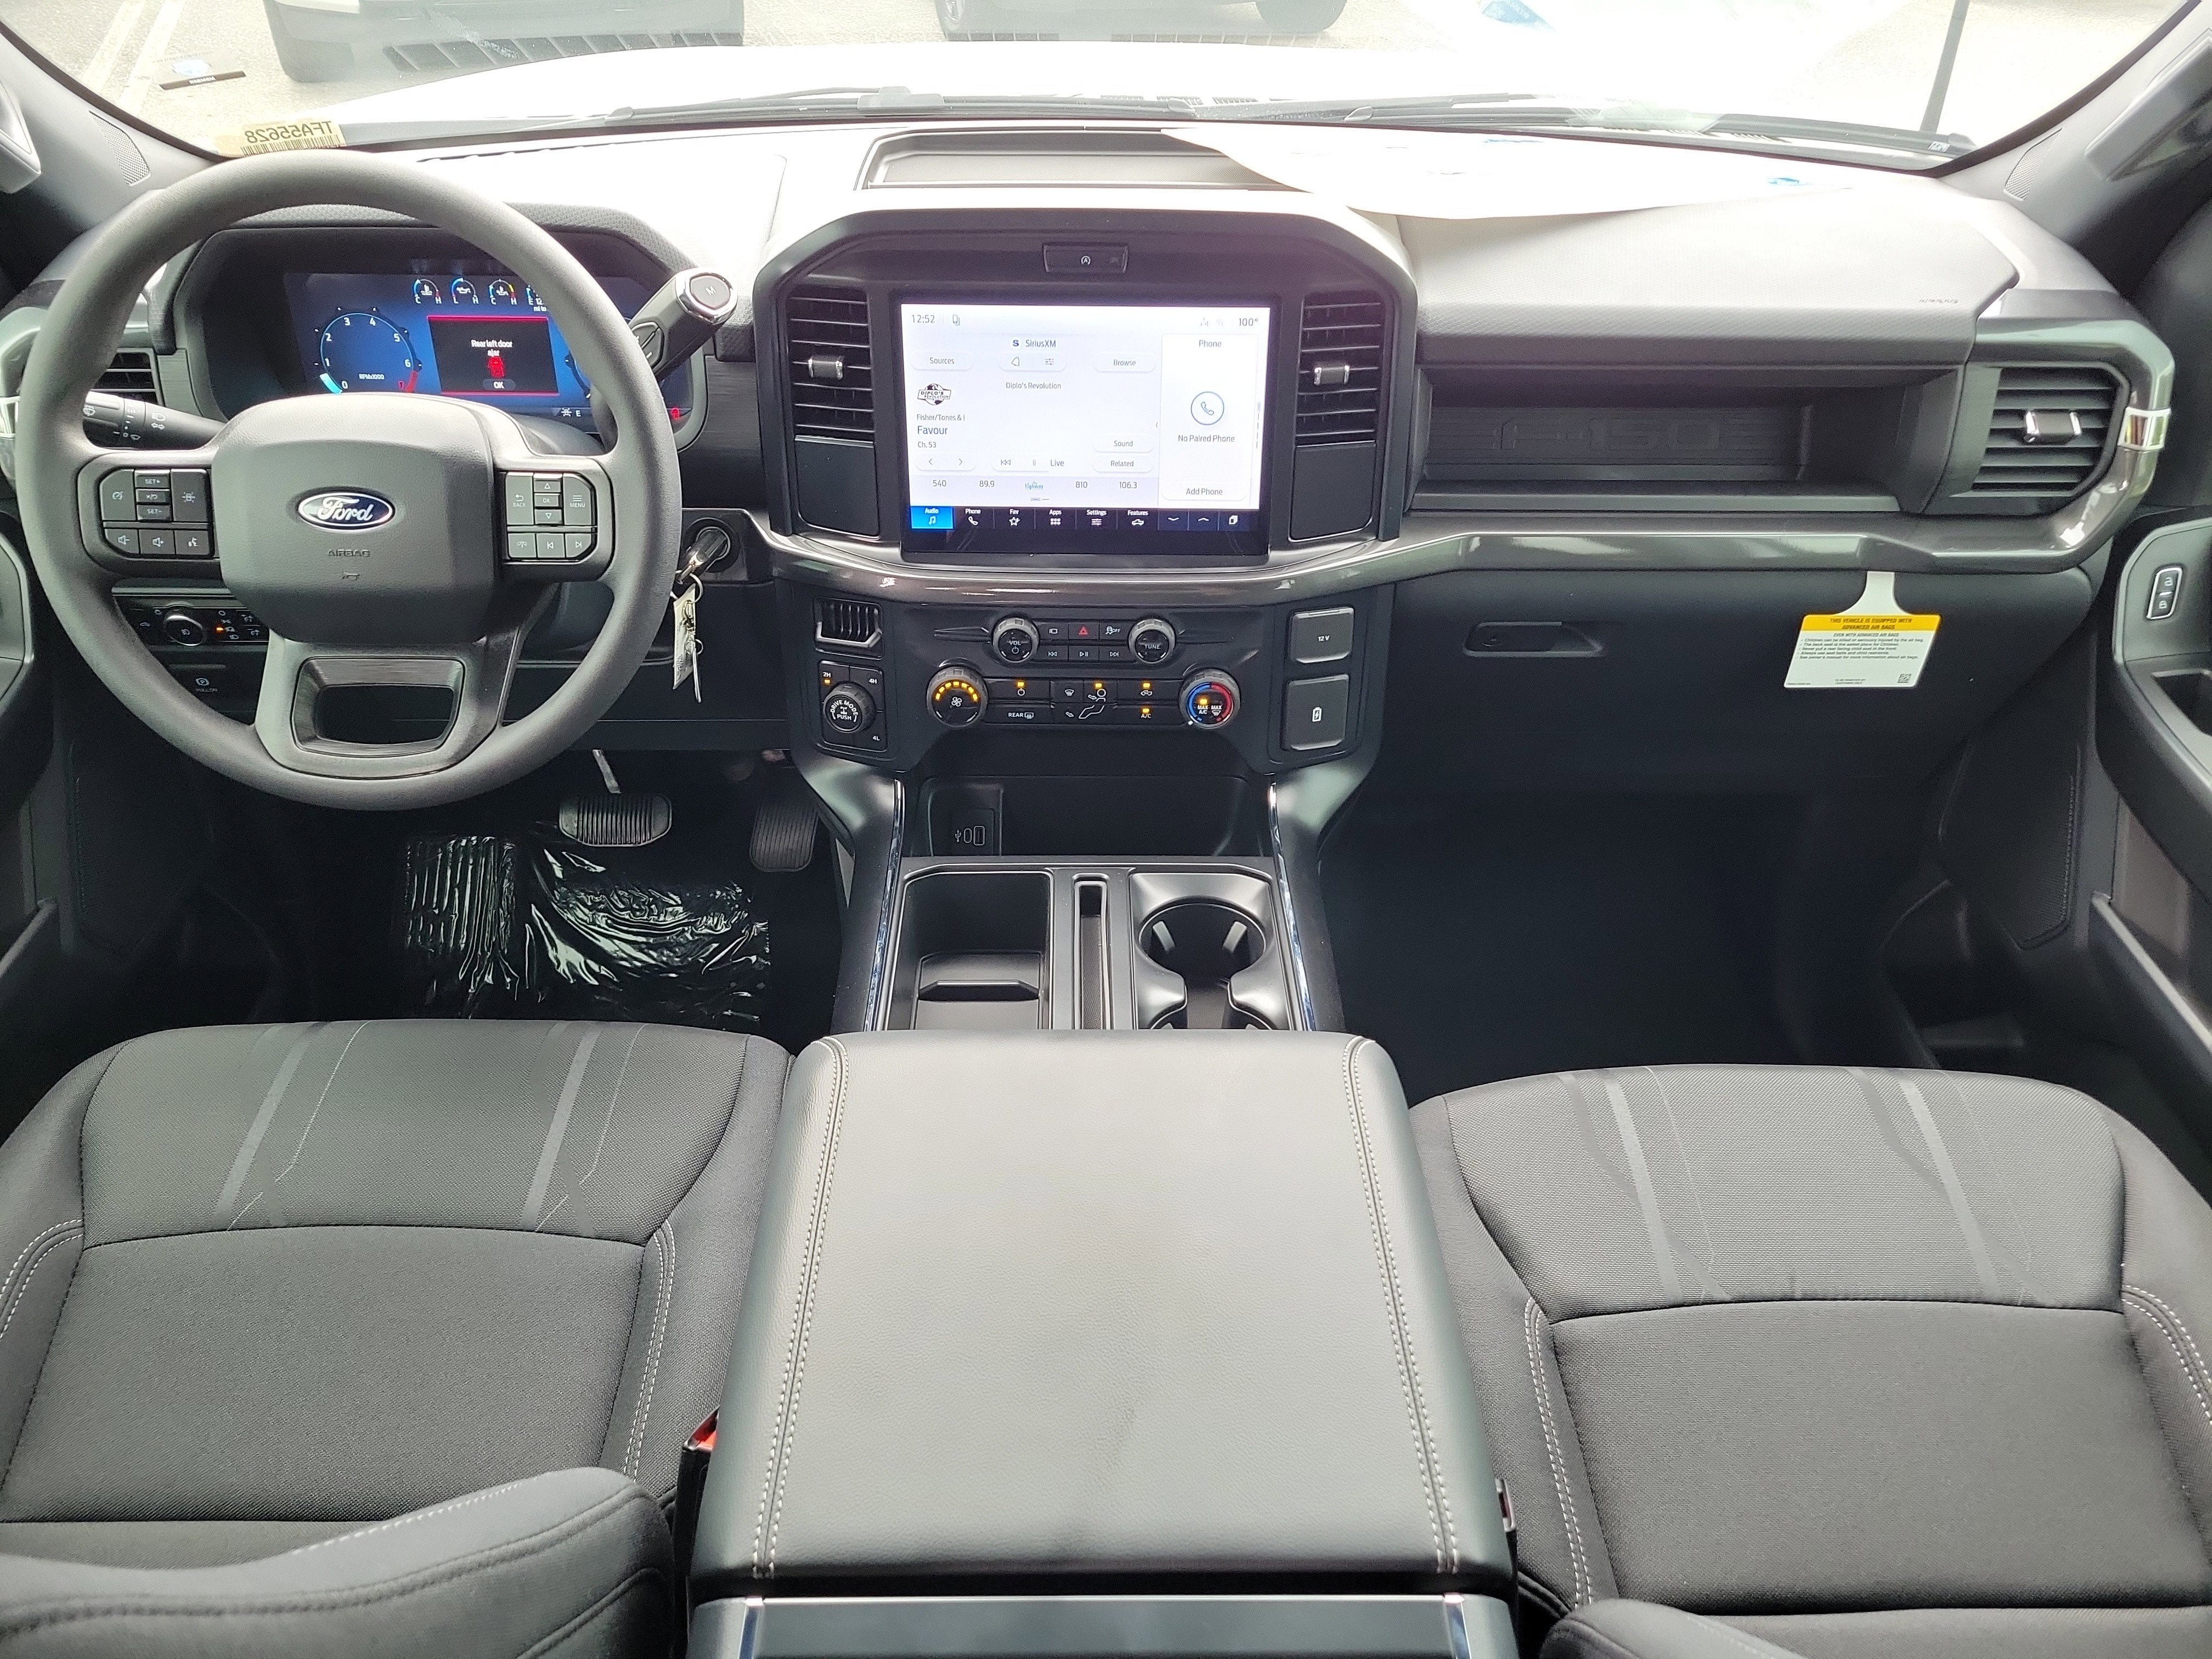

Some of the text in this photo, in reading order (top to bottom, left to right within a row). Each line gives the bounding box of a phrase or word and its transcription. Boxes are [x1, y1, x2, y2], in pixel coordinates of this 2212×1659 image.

[706, 286, 716, 296] M
[344, 317, 351, 326] 3
[370, 317, 376, 326] 4
[911, 314, 935, 324] 12:52
[325, 333, 332, 342] 2
[393, 334, 400, 342] 5
[471, 340, 513, 348] Rear left door
[1025, 340, 1056, 348] SiriusXM
[1199, 340, 1222, 348] Phone
[325, 358, 330, 367] 1
[404, 359, 411, 368] 6
[341, 381, 348, 389] 0
[1006, 381, 1027, 390] Diplo's
[917, 414, 956, 422] Fisher/Tones
[917, 425, 948, 435] Favour
[317, 496, 374, 521] Ford
[328, 549, 371, 557] AIRBAG
[830, 699, 859, 716] DRIVE MODE
